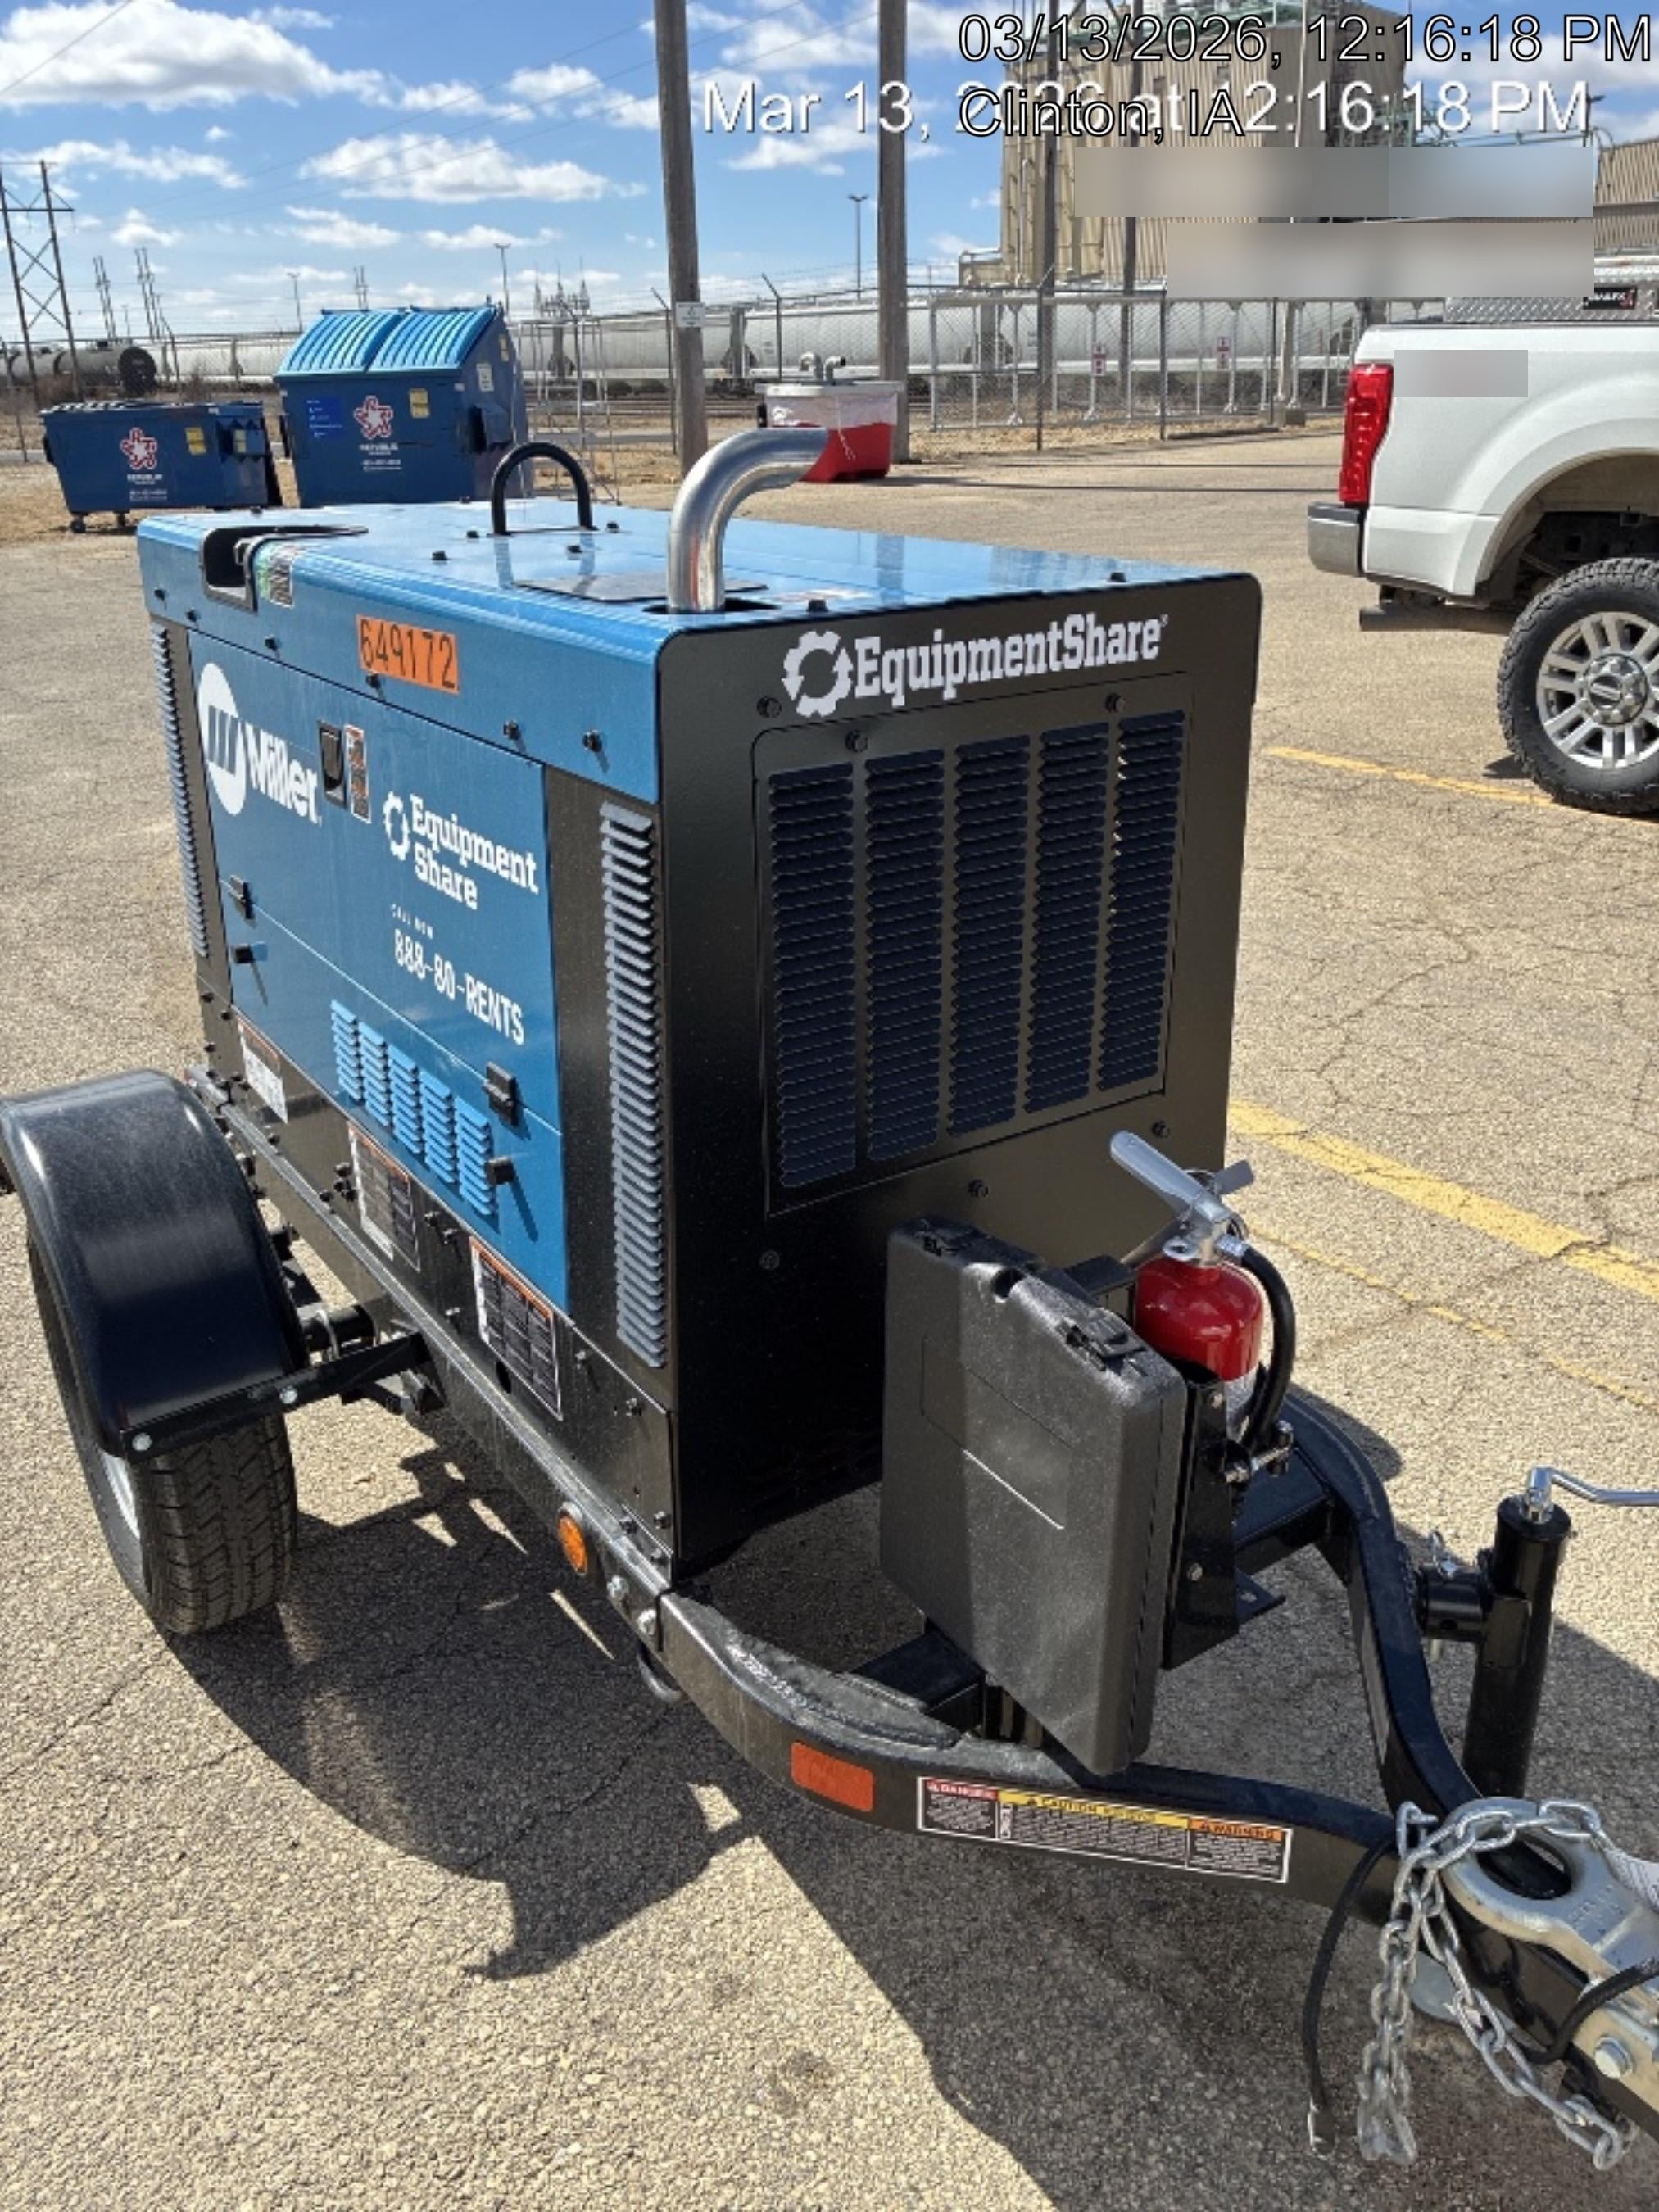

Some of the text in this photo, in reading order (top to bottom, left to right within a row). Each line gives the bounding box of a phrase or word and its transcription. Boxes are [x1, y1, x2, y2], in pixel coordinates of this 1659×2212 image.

[360, 618, 456, 689] 649172
[854, 613, 1163, 708] EquipmentShare
[245, 721, 319, 824] Miller
[410, 794, 539, 895] Equipment
[415, 842, 478, 910] Share
[395, 928, 525, 1046] 888-80-RENTS
